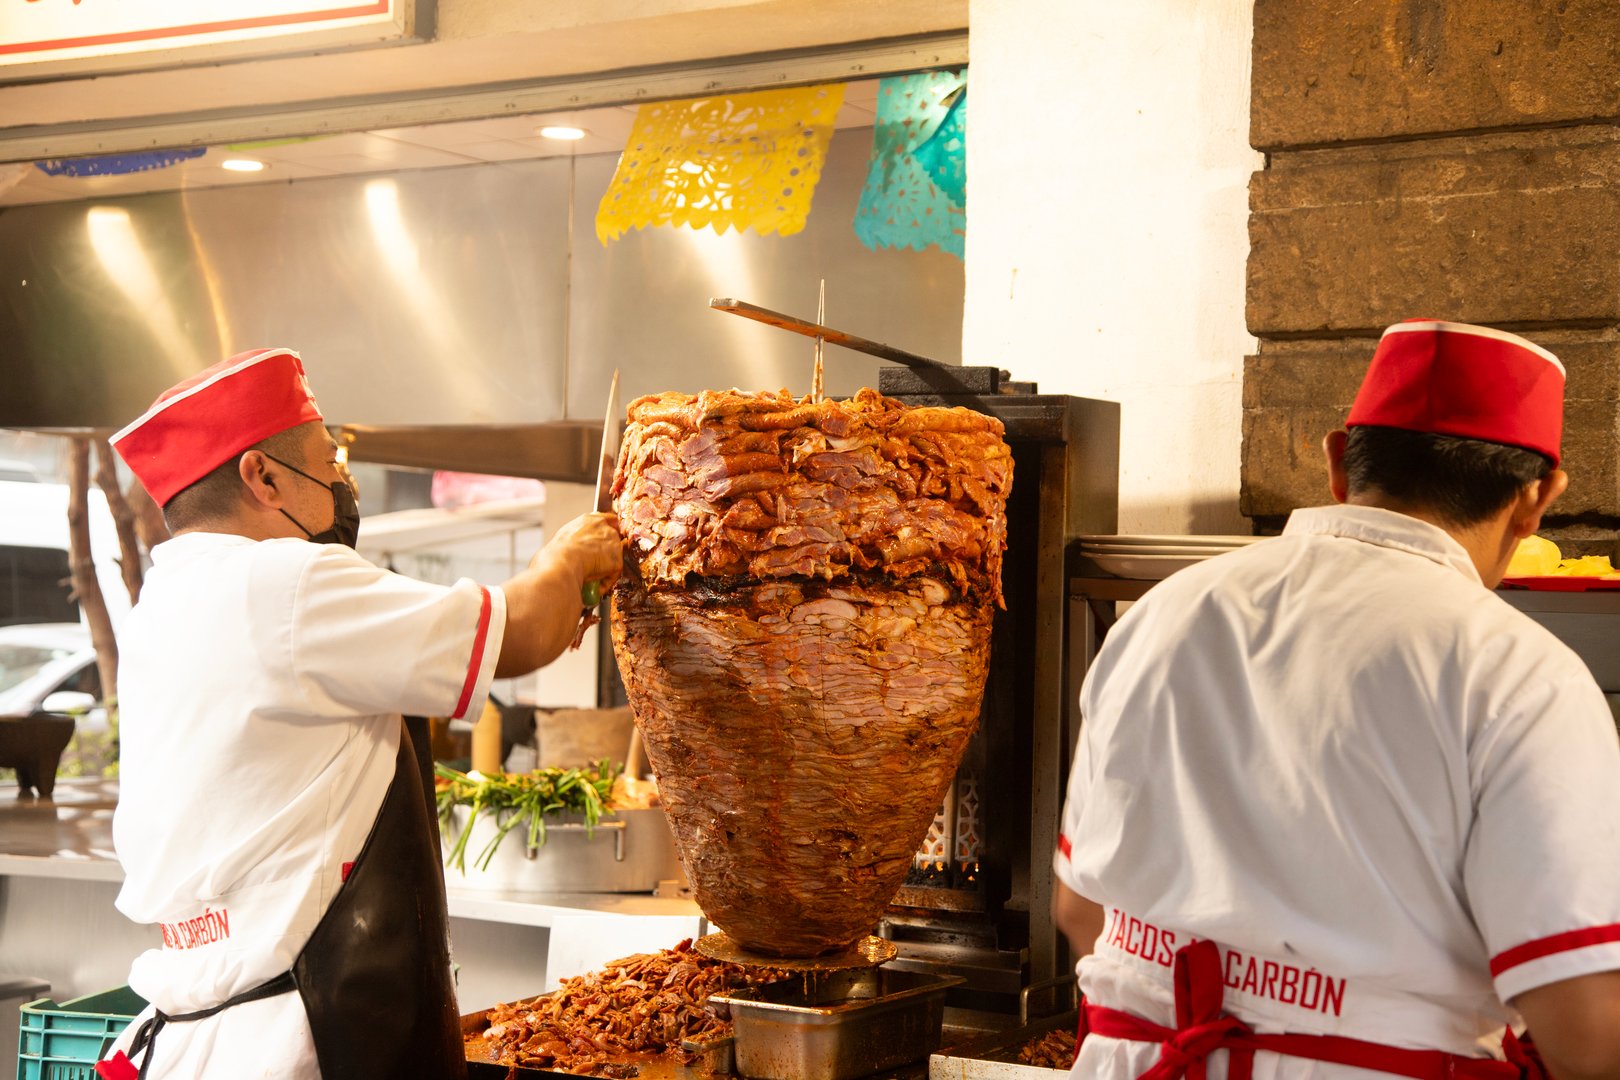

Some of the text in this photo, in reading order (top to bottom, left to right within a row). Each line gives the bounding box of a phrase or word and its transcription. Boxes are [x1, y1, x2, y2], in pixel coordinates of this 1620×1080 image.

[168, 922, 184, 950] AL
[178, 907, 230, 949] CARBÓN
[1106, 908, 1176, 968] TACOS
[1222, 949, 1347, 1018] CARBÓN
